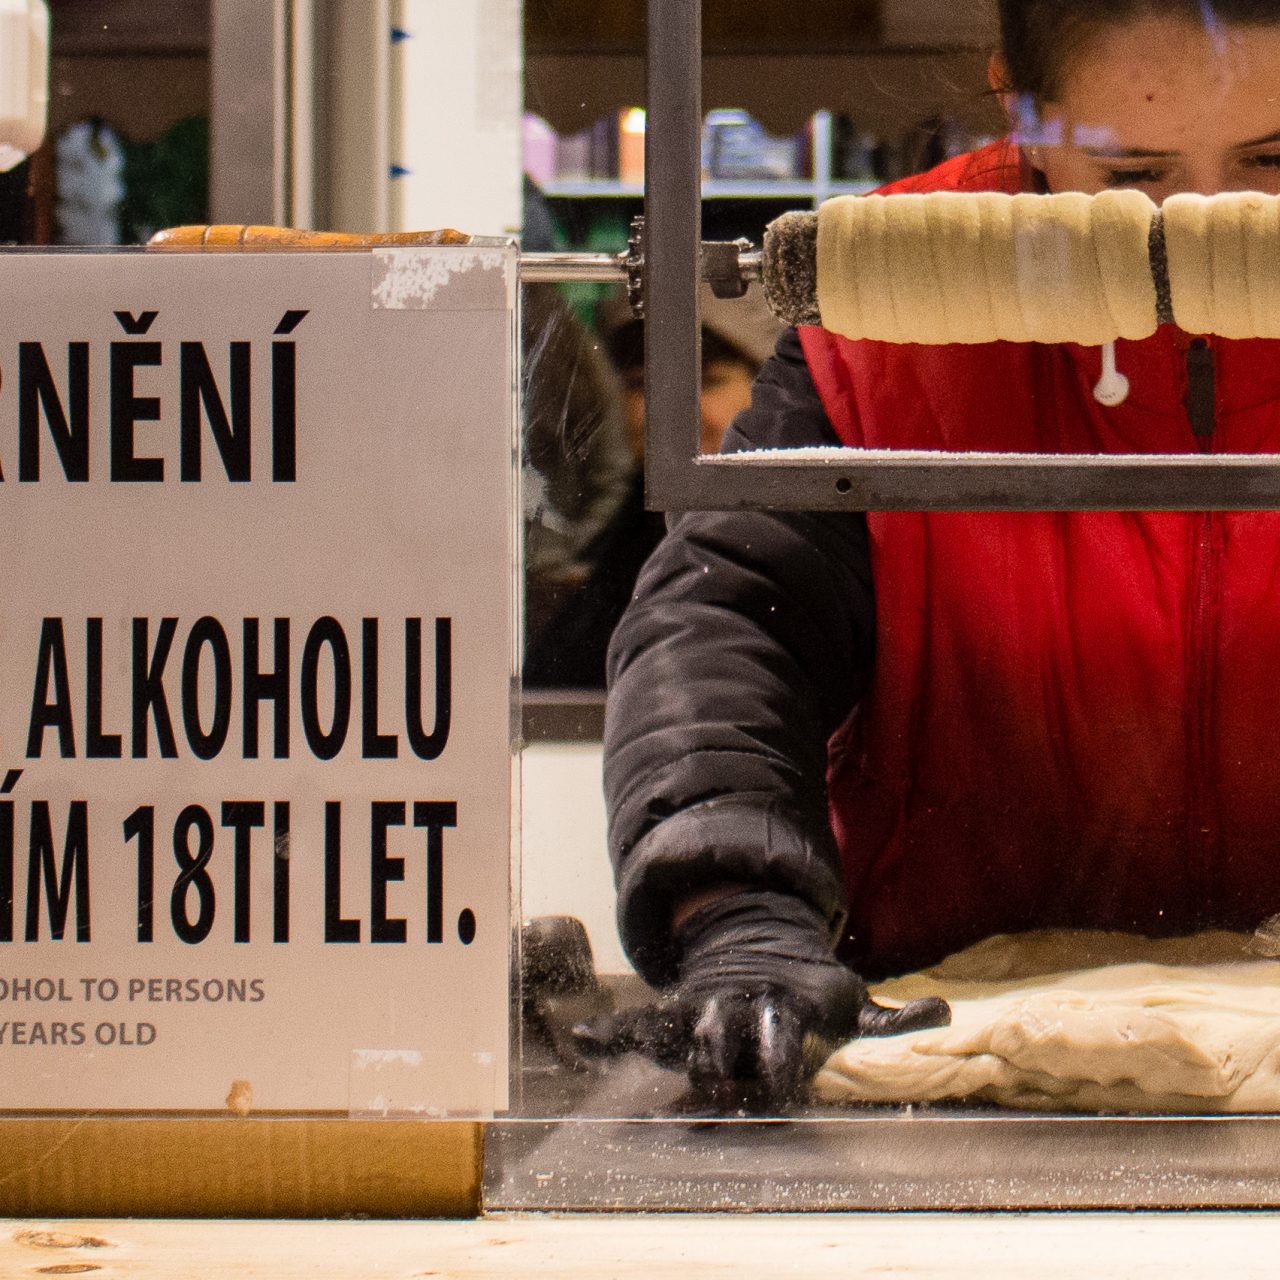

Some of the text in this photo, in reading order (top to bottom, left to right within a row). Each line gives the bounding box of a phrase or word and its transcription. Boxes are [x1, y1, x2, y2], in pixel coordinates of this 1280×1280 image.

[0, 309, 310, 483] NĚNÍ
[26, 616, 452, 761] ALKOHOLU
[122, 800, 291, 945] 18TI
[324, 800, 477, 945] LET.
[80, 978, 119, 1003] TO
[128, 978, 266, 1003] PERSONS
[94, 1021, 157, 1046] OLD
